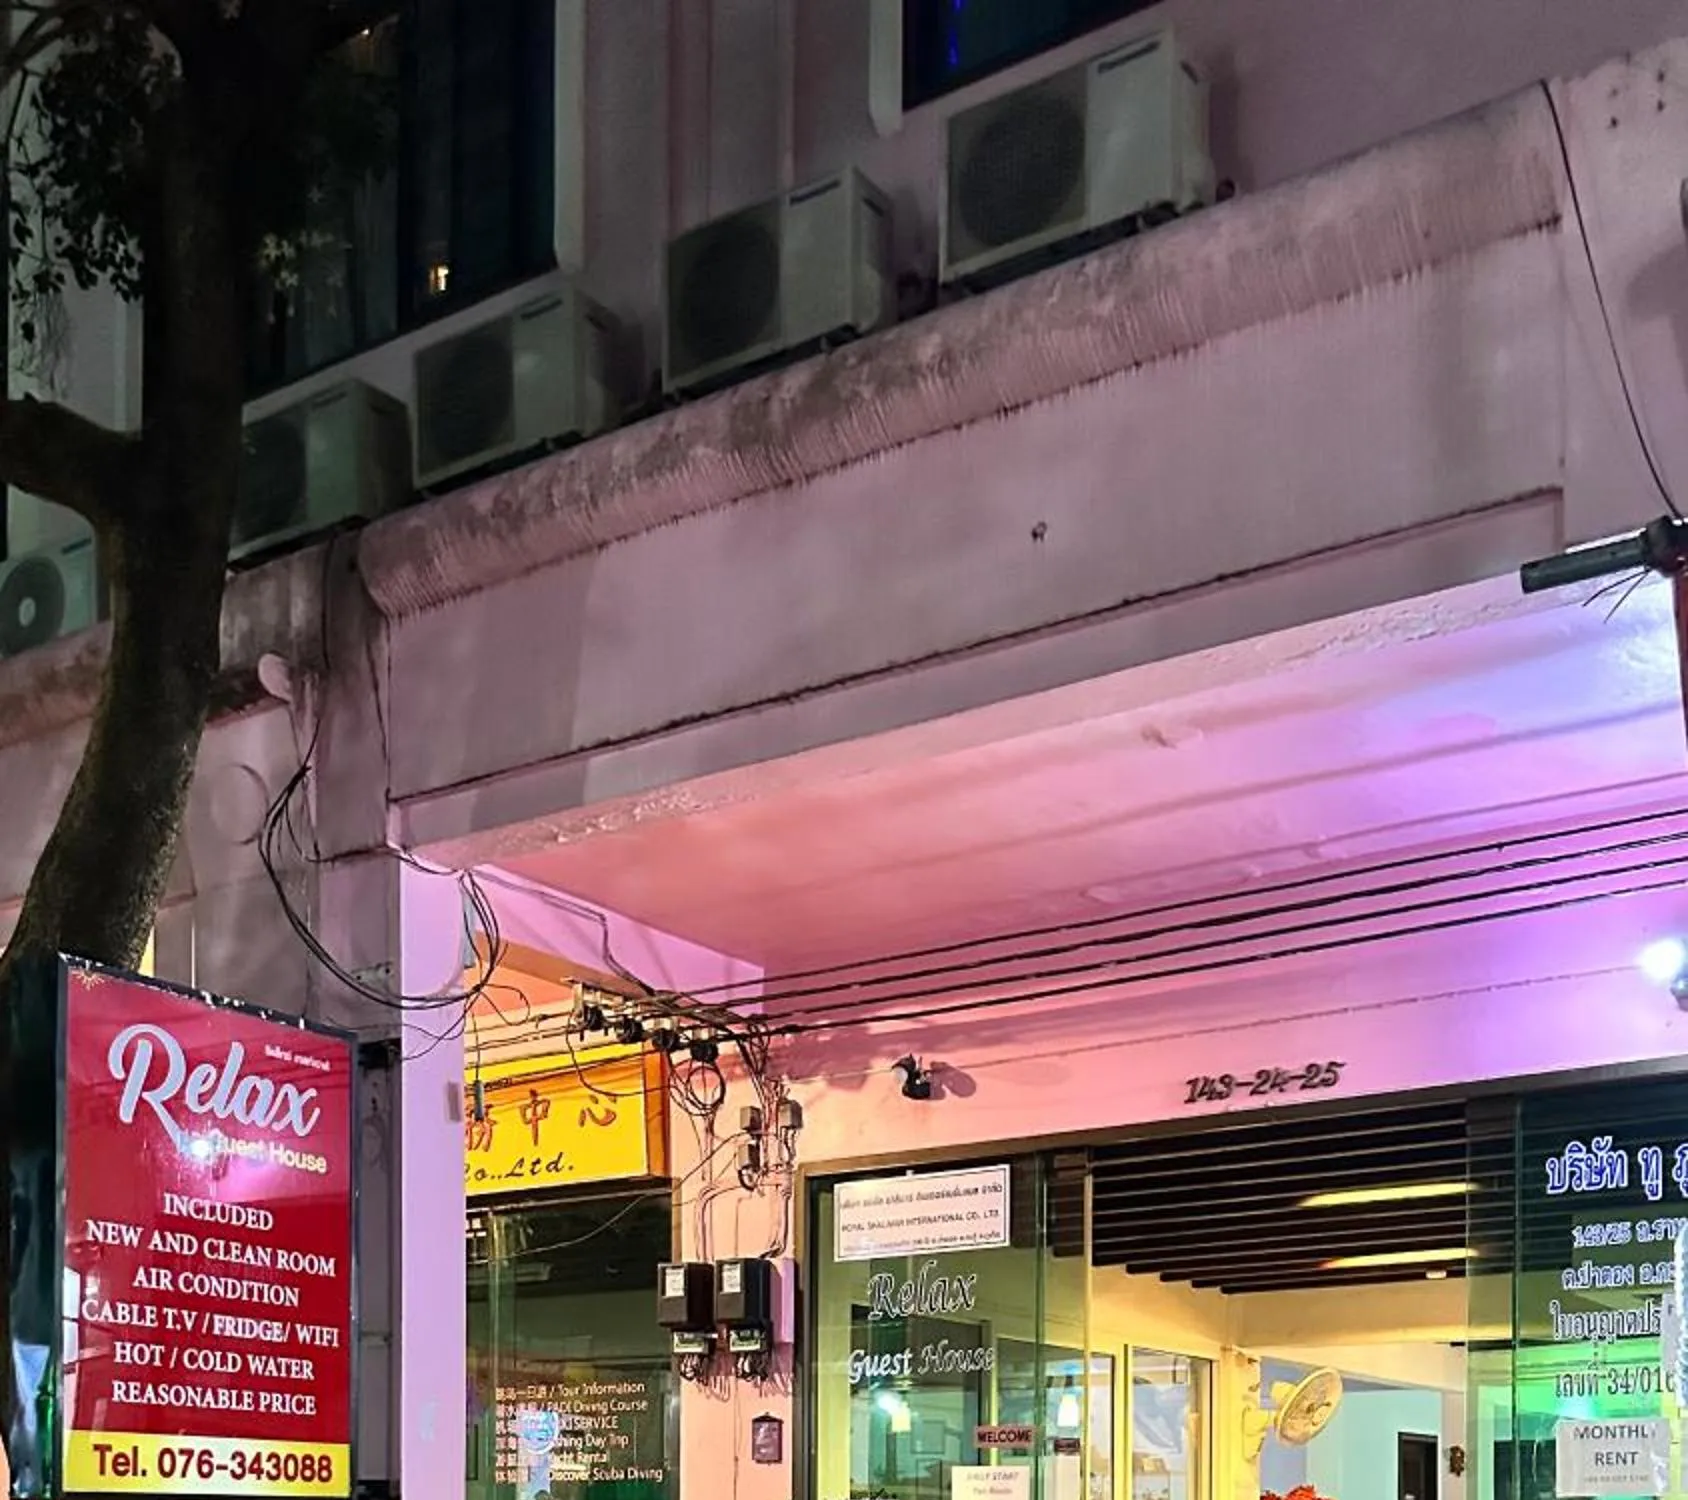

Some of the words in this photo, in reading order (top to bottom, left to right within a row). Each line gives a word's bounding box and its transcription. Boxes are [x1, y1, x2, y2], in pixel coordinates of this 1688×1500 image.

[108, 1023, 321, 1152] Relax
[1184, 1061, 1347, 1104] 143-24-25
[268, 1140, 328, 1174] House
[1545, 1136, 1629, 1194] บริษัท
[1637, 1145, 1664, 1201] ทู
[163, 1192, 273, 1231] INCLUDED
[85, 1219, 145, 1248] NEW
[148, 1230, 199, 1256] AND
[203, 1237, 272, 1267] CLEAN
[276, 1249, 337, 1277] ROOM
[132, 1265, 175, 1292] AIR
[178, 1273, 301, 1307] CONDITION
[867, 1259, 977, 1321] Relax
[81, 1299, 159, 1328] CABLE
[163, 1306, 198, 1332] T.V
[294, 1323, 341, 1348] WIFI
[113, 1341, 165, 1367] HOT
[183, 1347, 242, 1374] COLD
[247, 1353, 316, 1380] WATER
[848, 1348, 913, 1385] Guest
[918, 1338, 996, 1375] House
[112, 1380, 255, 1411] REASONABLE
[259, 1391, 317, 1416] PRICE
[558, 1383, 580, 1396] Tour
[583, 1381, 645, 1395] Information
[575, 1400, 609, 1415] Diving
[610, 1399, 648, 1412] Course
[575, 1415, 619, 1430] SERVICE
[585, 1434, 608, 1449] Day
[977, 1429, 1033, 1443] WELCOME
[93, 1443, 148, 1478] Tel.
[157, 1447, 333, 1483] 076-343088
[593, 1467, 625, 1480] Scuba
[627, 1467, 664, 1483] Diving
[1594, 1451, 1640, 1466] RENT
